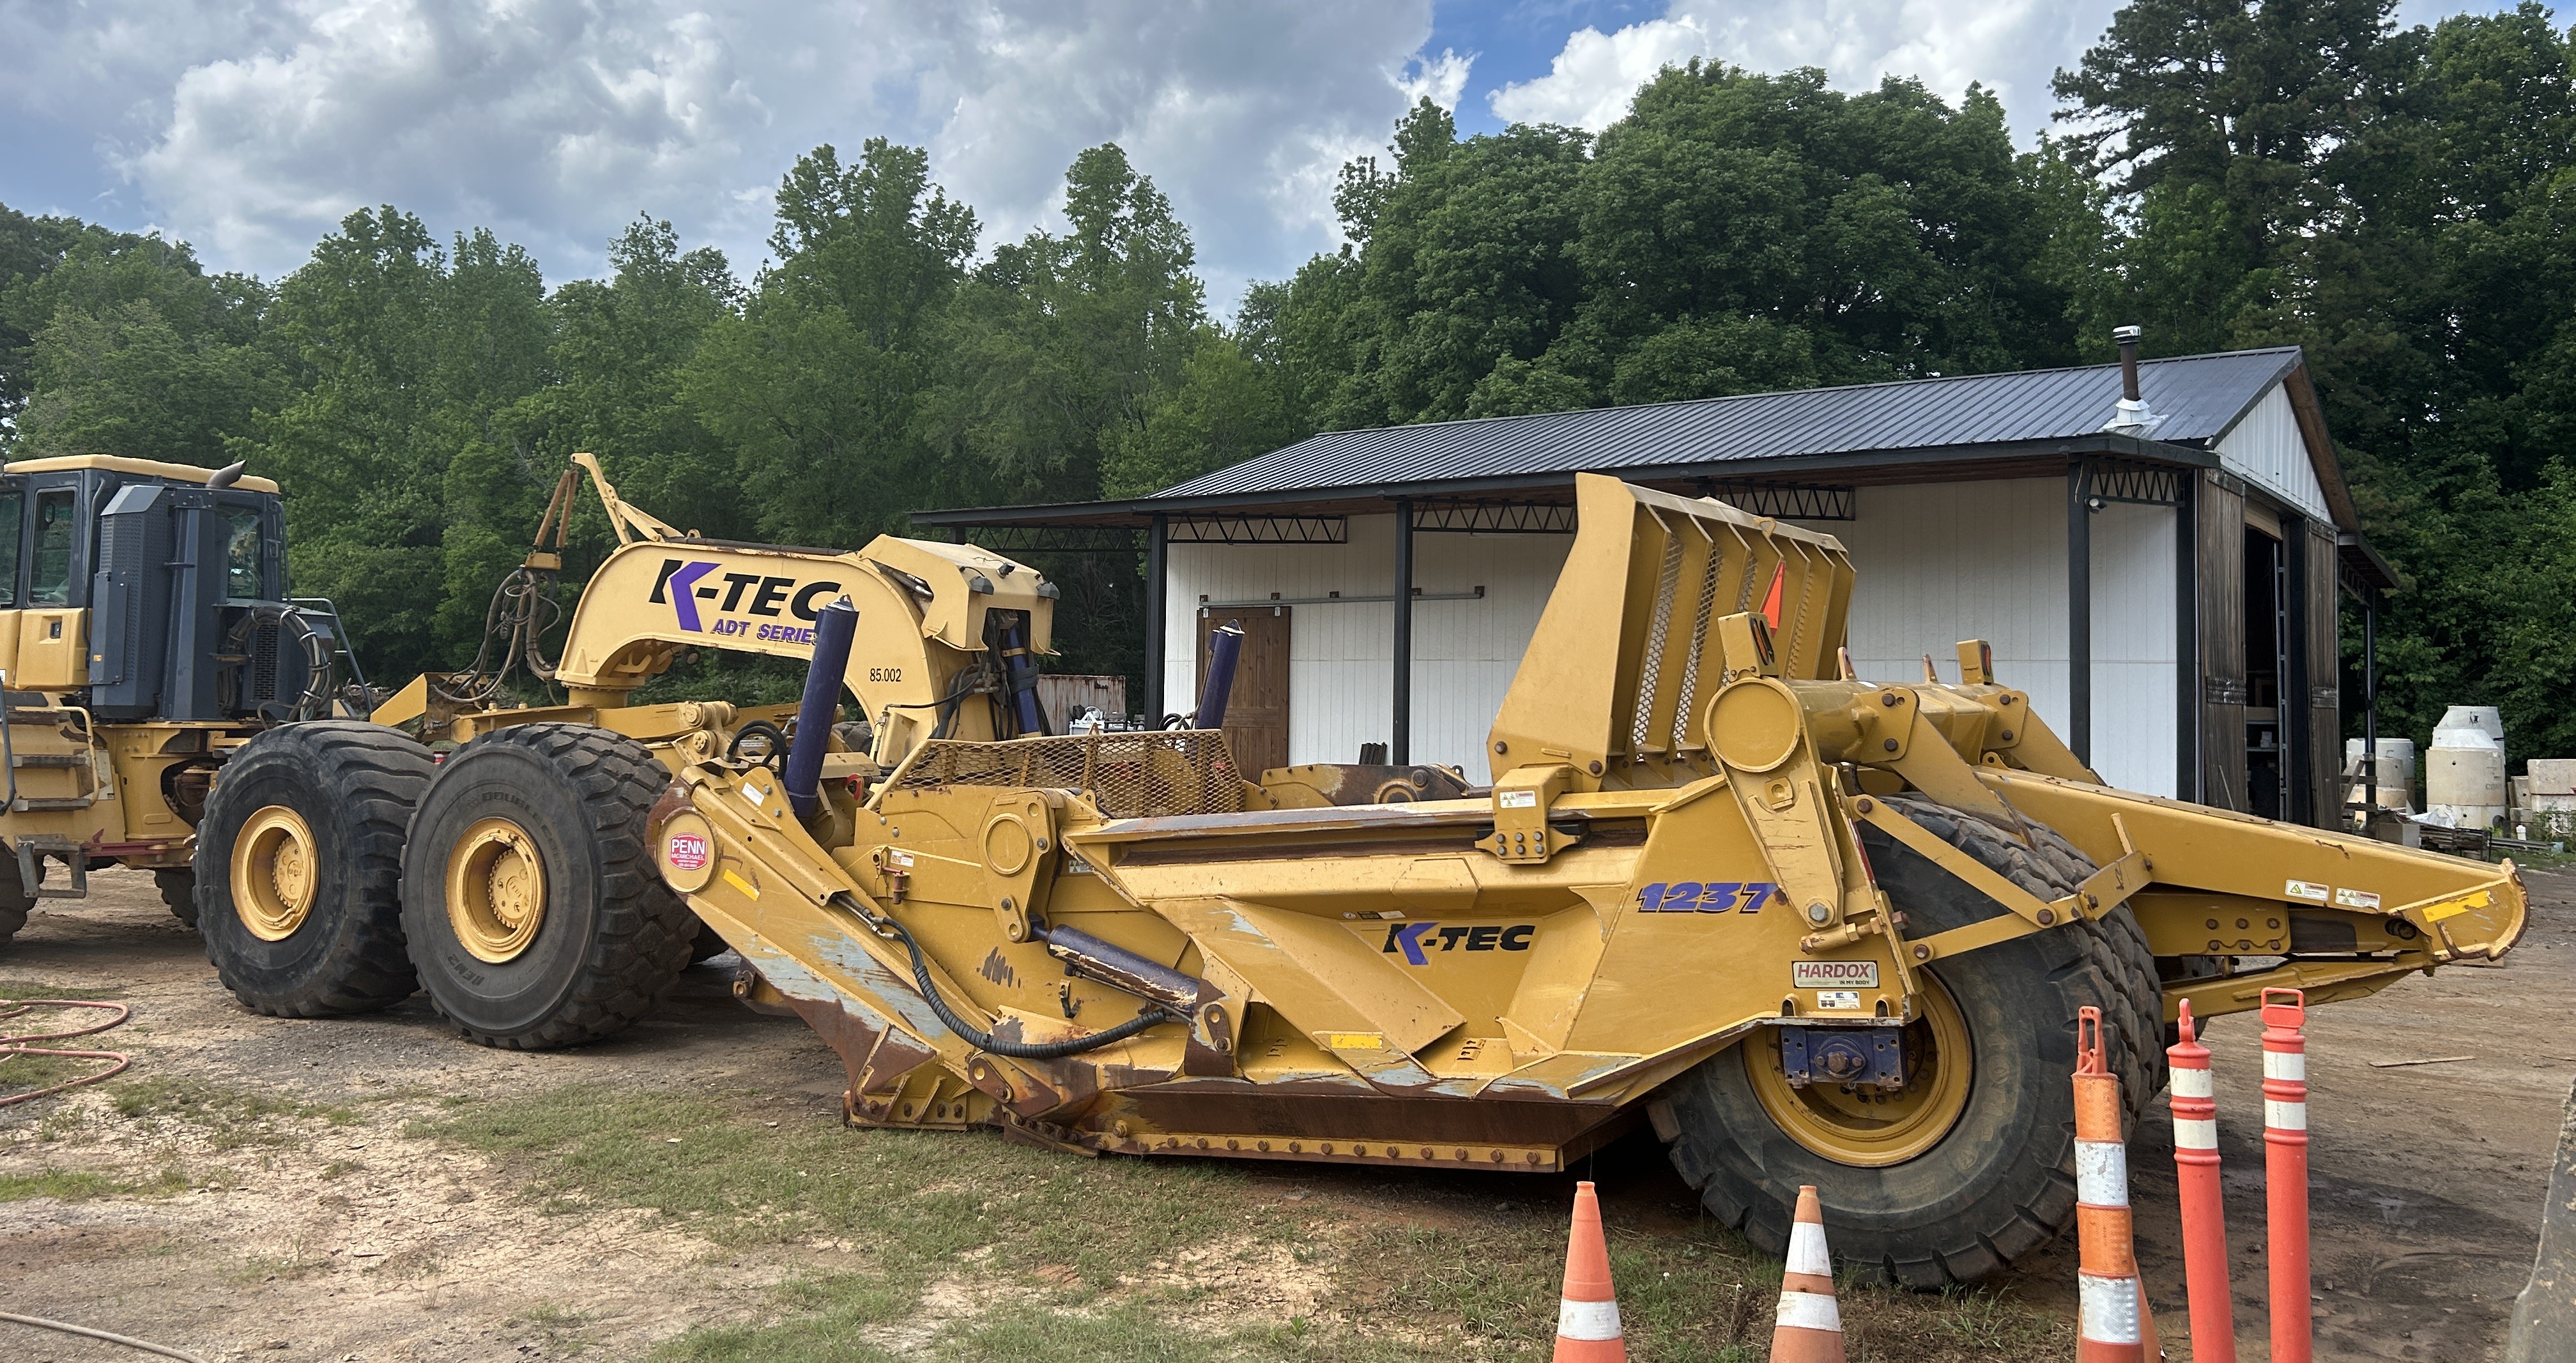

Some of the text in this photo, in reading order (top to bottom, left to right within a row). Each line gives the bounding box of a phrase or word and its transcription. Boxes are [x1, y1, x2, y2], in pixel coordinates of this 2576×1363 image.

[648, 559, 842, 633] K-TEC
[710, 618, 818, 645] ADT SERIE
[870, 667, 901, 682] 85.002
[671, 839, 705, 855] PENN
[1636, 881, 1780, 914] 1237
[1383, 921, 1536, 966] K-TEC
[1798, 964, 1871, 978] HARDOX
